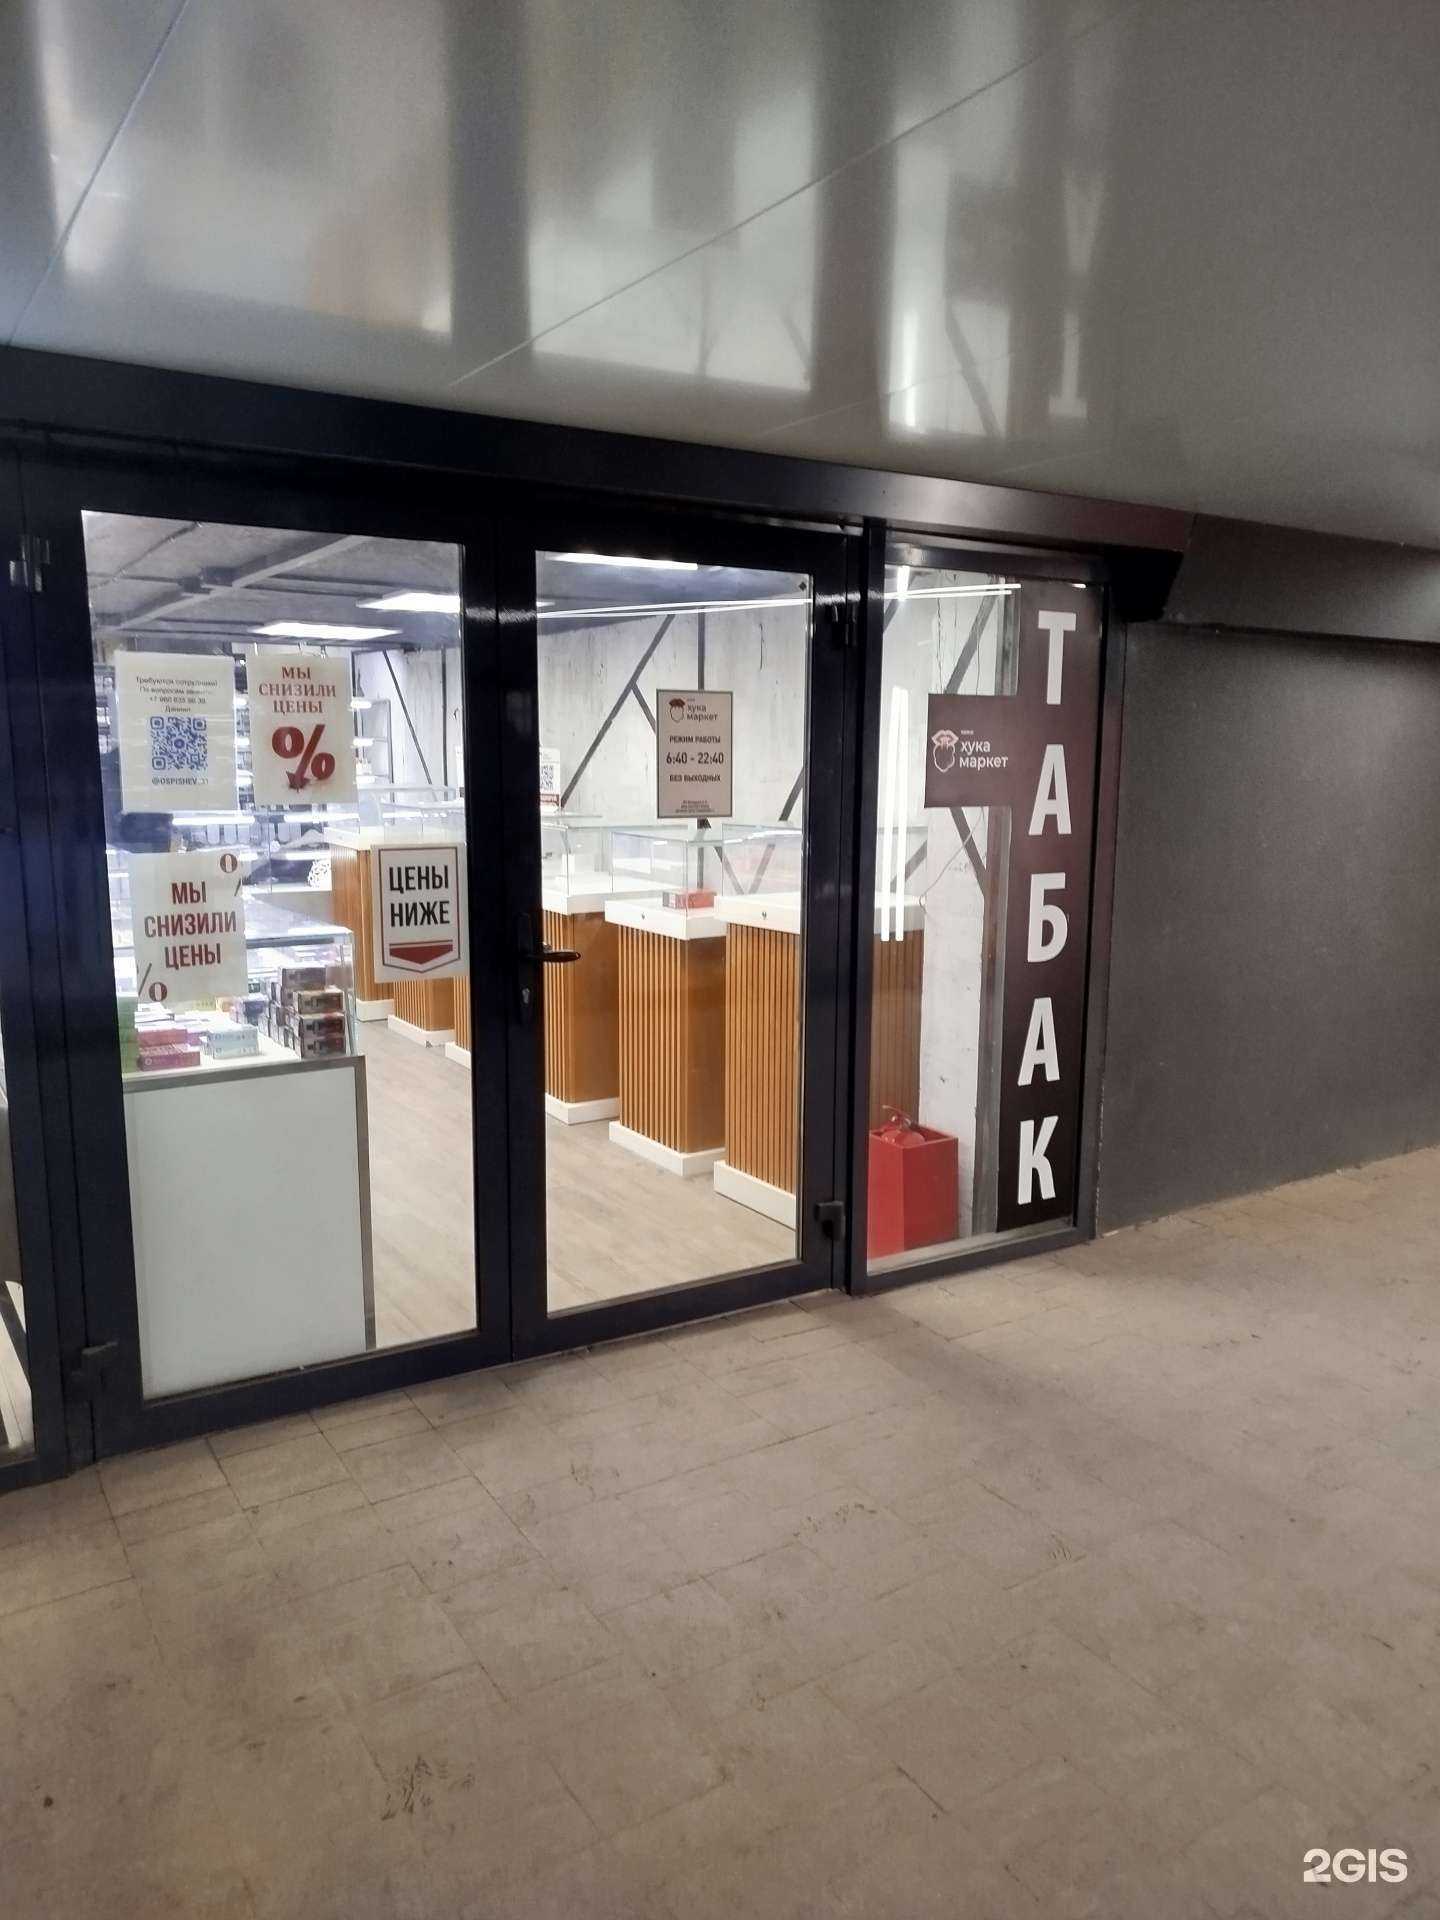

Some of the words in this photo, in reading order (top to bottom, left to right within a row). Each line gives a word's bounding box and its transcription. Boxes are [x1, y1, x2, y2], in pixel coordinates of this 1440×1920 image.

[281, 666, 311, 680] МЫ
[258, 683, 337, 698] СНИЗИЛИ
[272, 700, 324, 715] ЦЕНЫ
[686, 713, 718, 723] маркет
[669, 735, 694, 744] РЕЖИМ
[695, 735, 721, 744] РАБОТЫ
[961, 741, 991, 756] хука
[666, 752, 688, 765] 6:40
[697, 752, 724, 765] 22:40
[959, 756, 1009, 772] маркет
[669, 774, 682, 782] БЕЗ
[683, 774, 721, 784] ВЫХОДНЫХ
[389, 864, 449, 894] ЦЕНЫ
[171, 881, 207, 905] МЫ
[390, 900, 451, 928] НИЖЕ
[1017, 610, 1077, 1206] ТАБАК
[144, 910, 237, 939] СНИЗИЛИ
[164, 943, 221, 970] ЦЕНЫ
